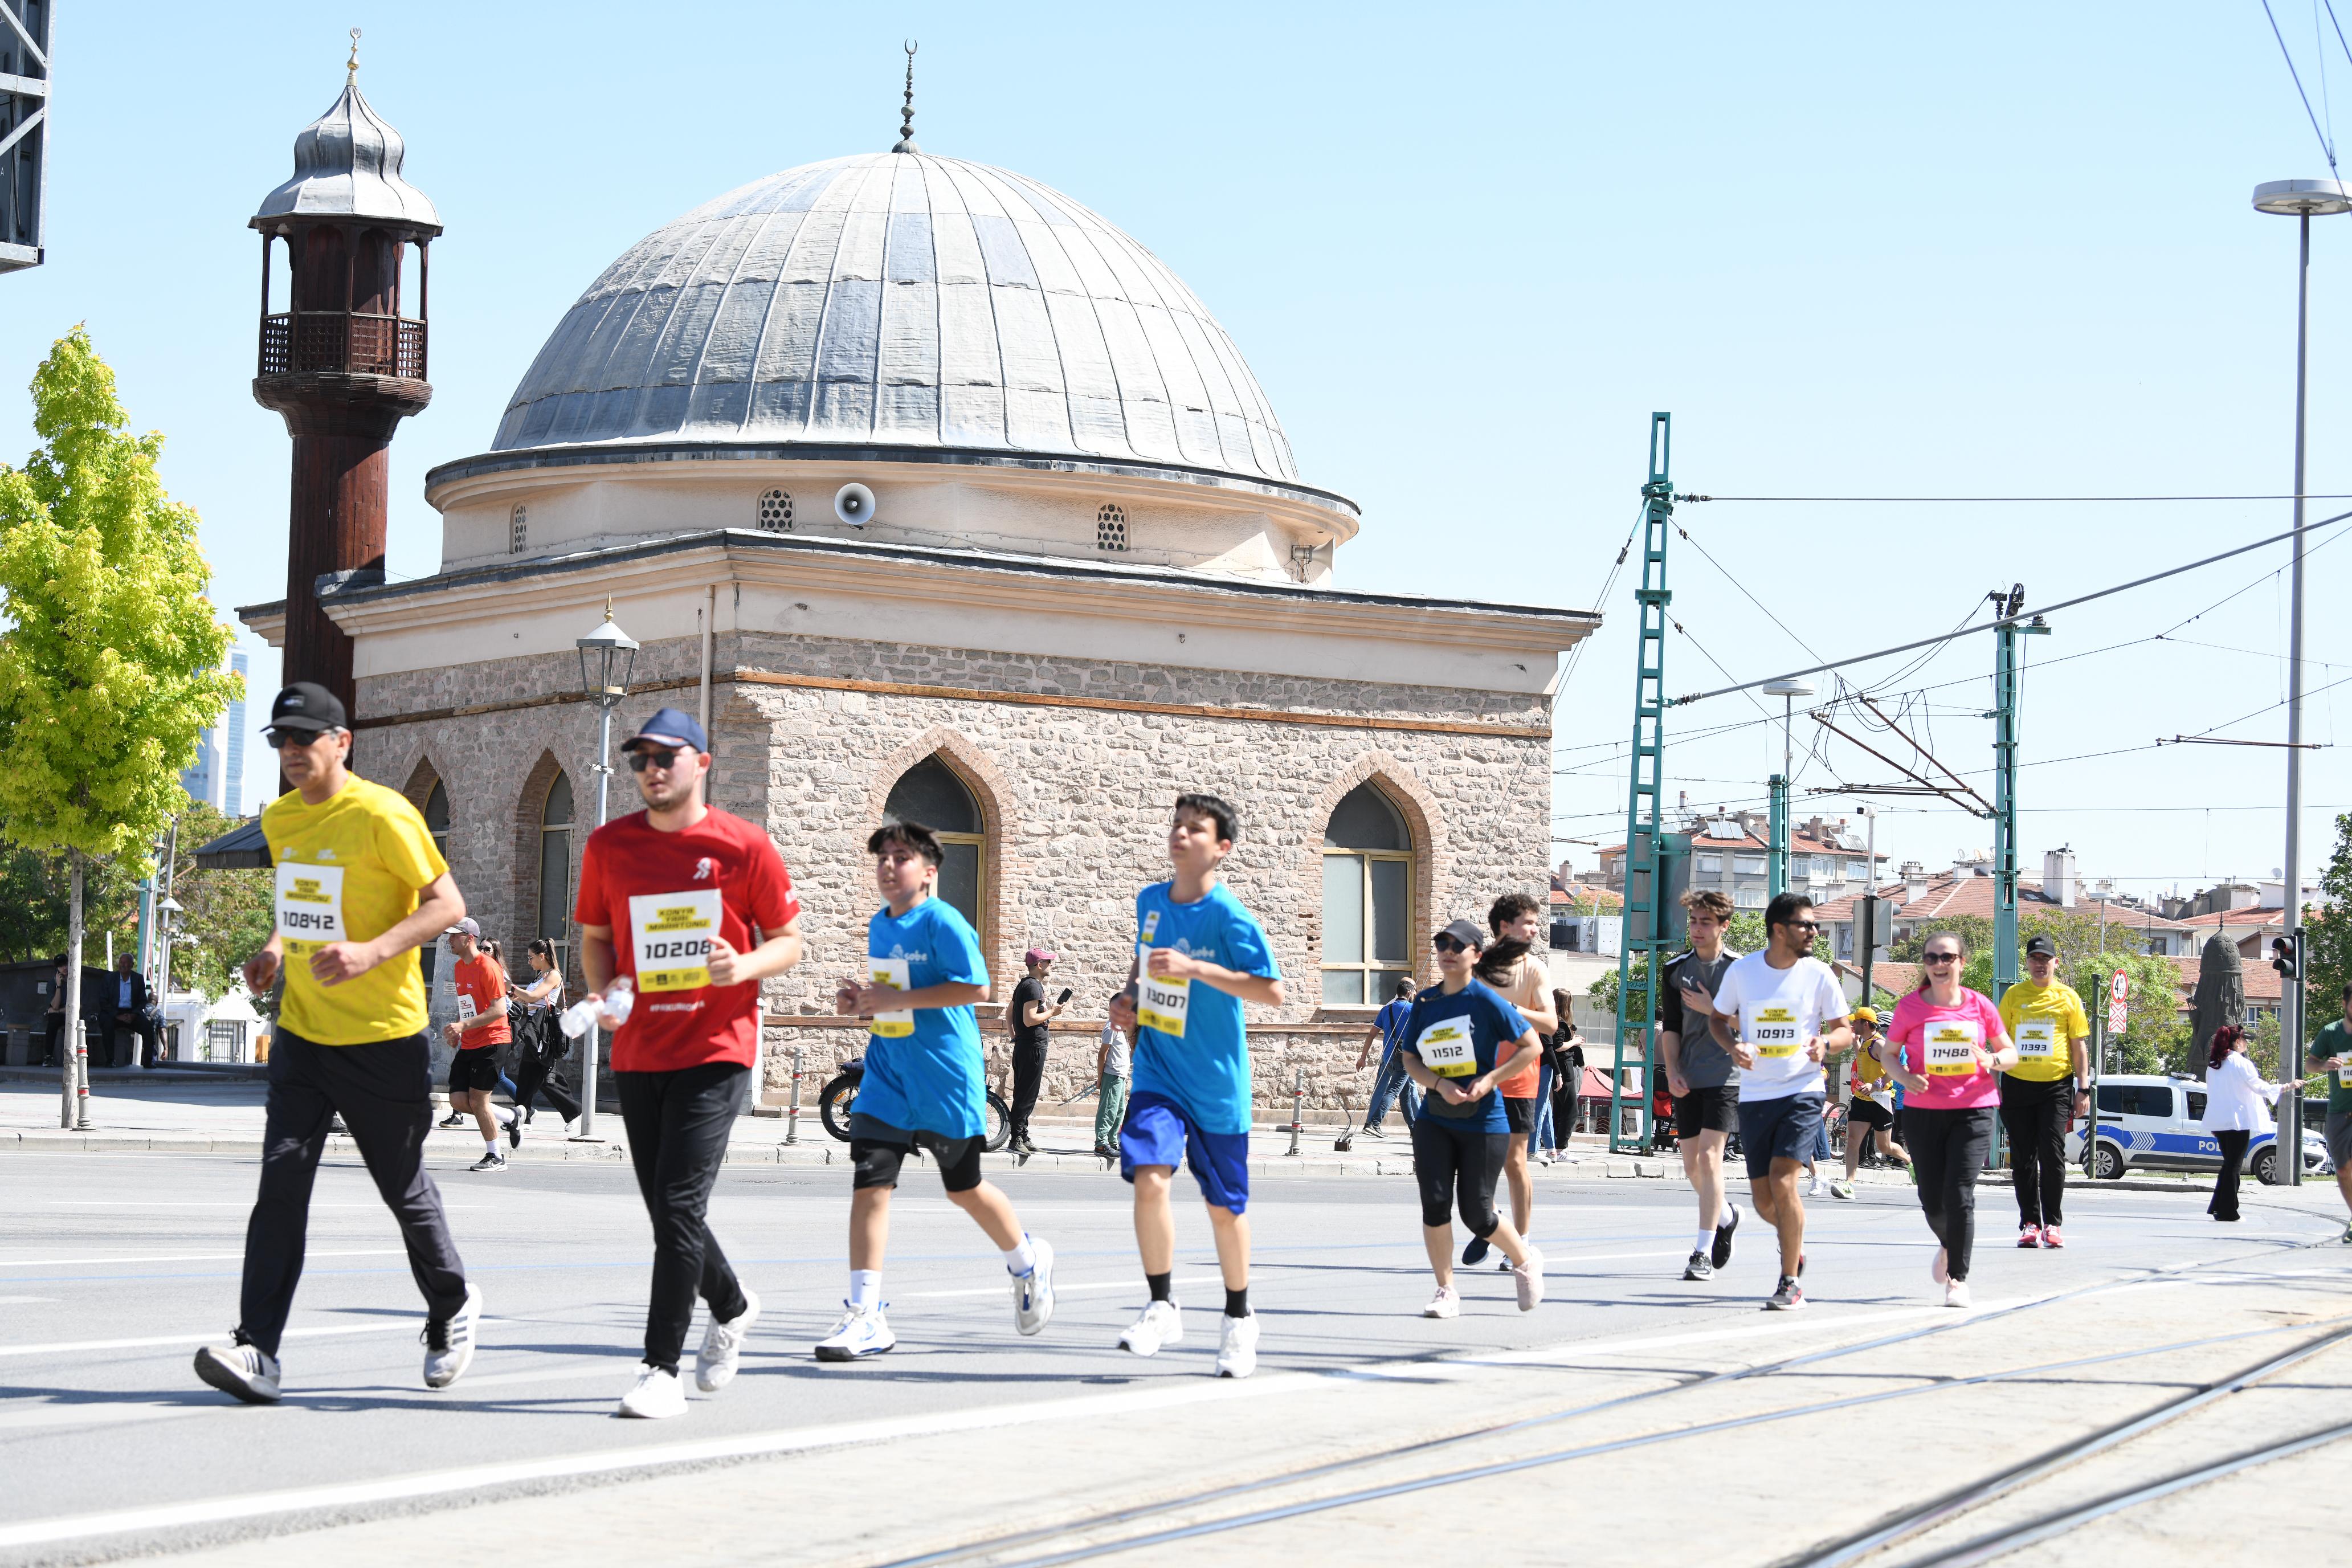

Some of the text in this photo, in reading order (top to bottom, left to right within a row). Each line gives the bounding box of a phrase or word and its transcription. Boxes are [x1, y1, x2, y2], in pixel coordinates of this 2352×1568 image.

[283, 912, 334, 930] 10842
[646, 940, 711, 959] 10208
[2114, 978, 2119, 994] 4
[1146, 987, 1186, 1009] 13007
[1757, 1029, 1794, 1038] 10913
[1432, 1046, 1463, 1058] 11512
[1933, 1048, 1969, 1057] 11488
[2199, 1141, 2221, 1152] POL
